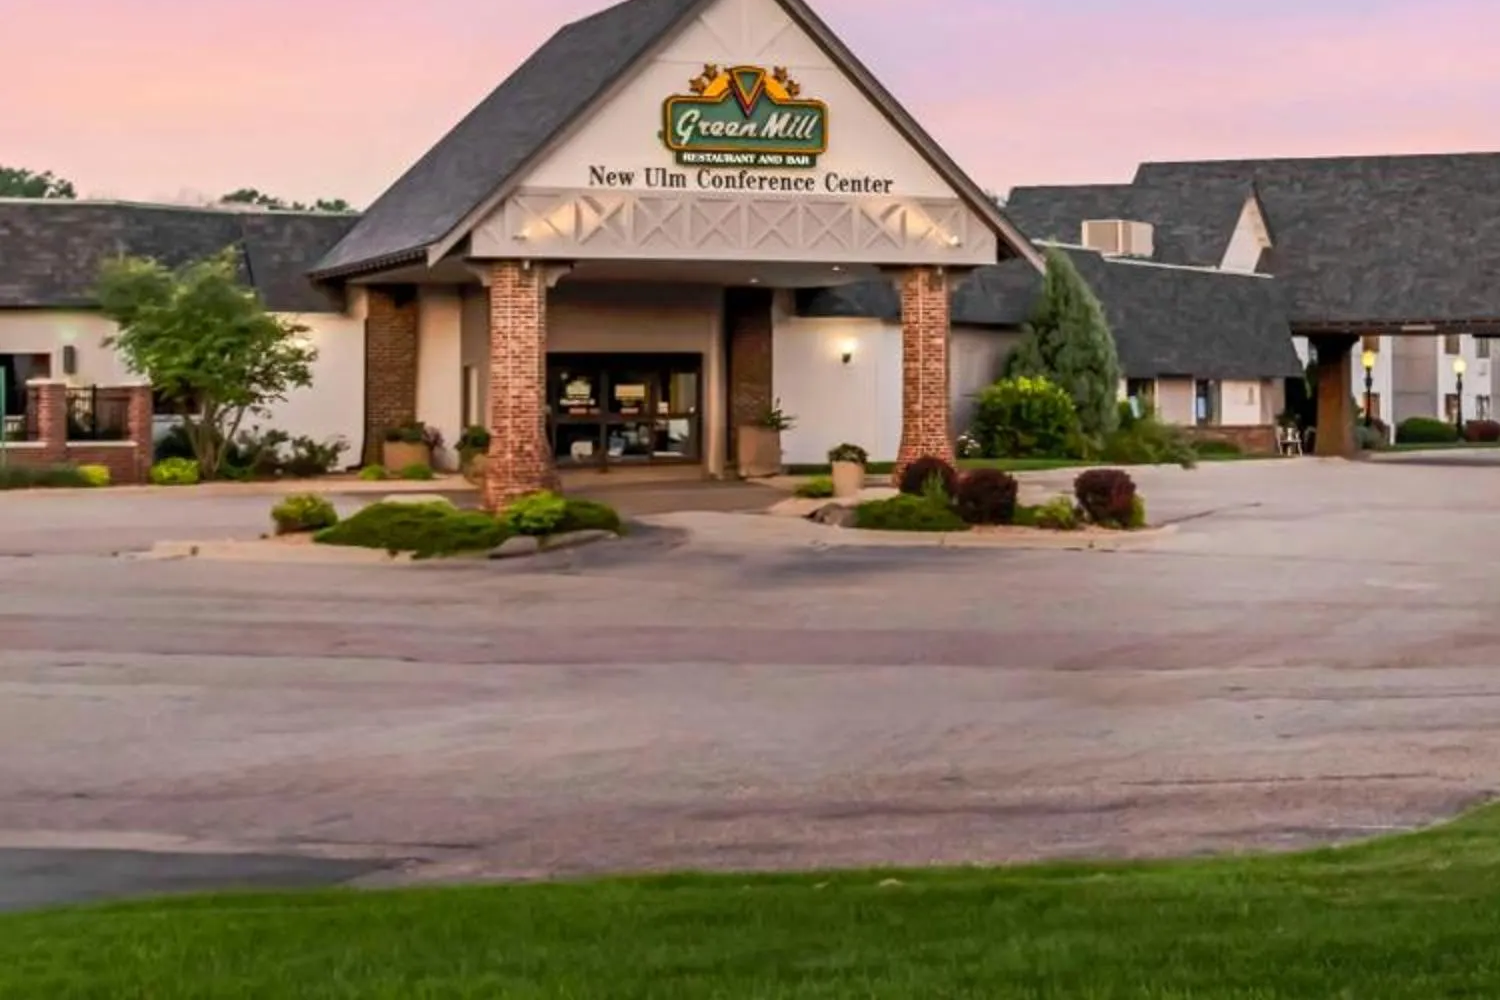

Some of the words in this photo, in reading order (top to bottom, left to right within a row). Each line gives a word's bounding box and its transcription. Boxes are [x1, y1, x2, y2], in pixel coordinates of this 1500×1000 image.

[676, 108, 757, 146] Green
[760, 111, 818, 139] Mill
[683, 151, 755, 164] RESTAURANT
[757, 154, 783, 165] AND
[786, 155, 810, 165] BAR
[588, 165, 635, 187] New
[644, 167, 687, 188] Ulm
[696, 169, 815, 192] Conference
[824, 172, 894, 194] Center
